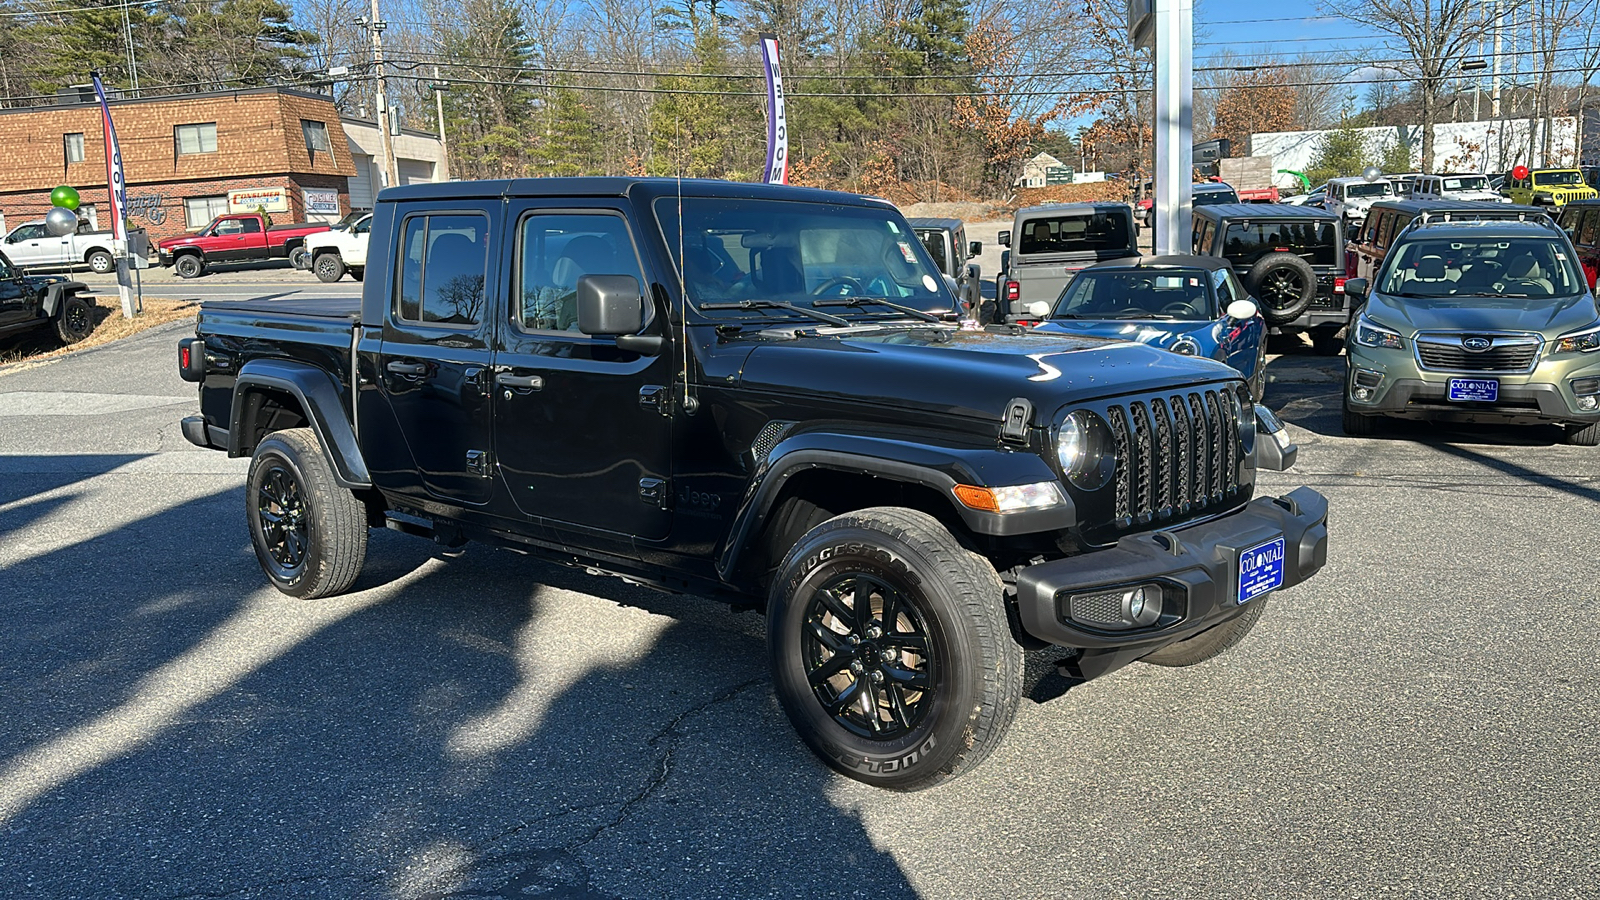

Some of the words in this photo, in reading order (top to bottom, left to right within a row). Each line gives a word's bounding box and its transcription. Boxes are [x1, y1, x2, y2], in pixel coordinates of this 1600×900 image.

[233, 191, 280, 205] CONSUMER
[308, 193, 337, 210] CONSUMER
[1451, 381, 1496, 390] COLONIAL
[679, 486, 721, 511] Jeep
[1241, 547, 1283, 574] COLONIAL
